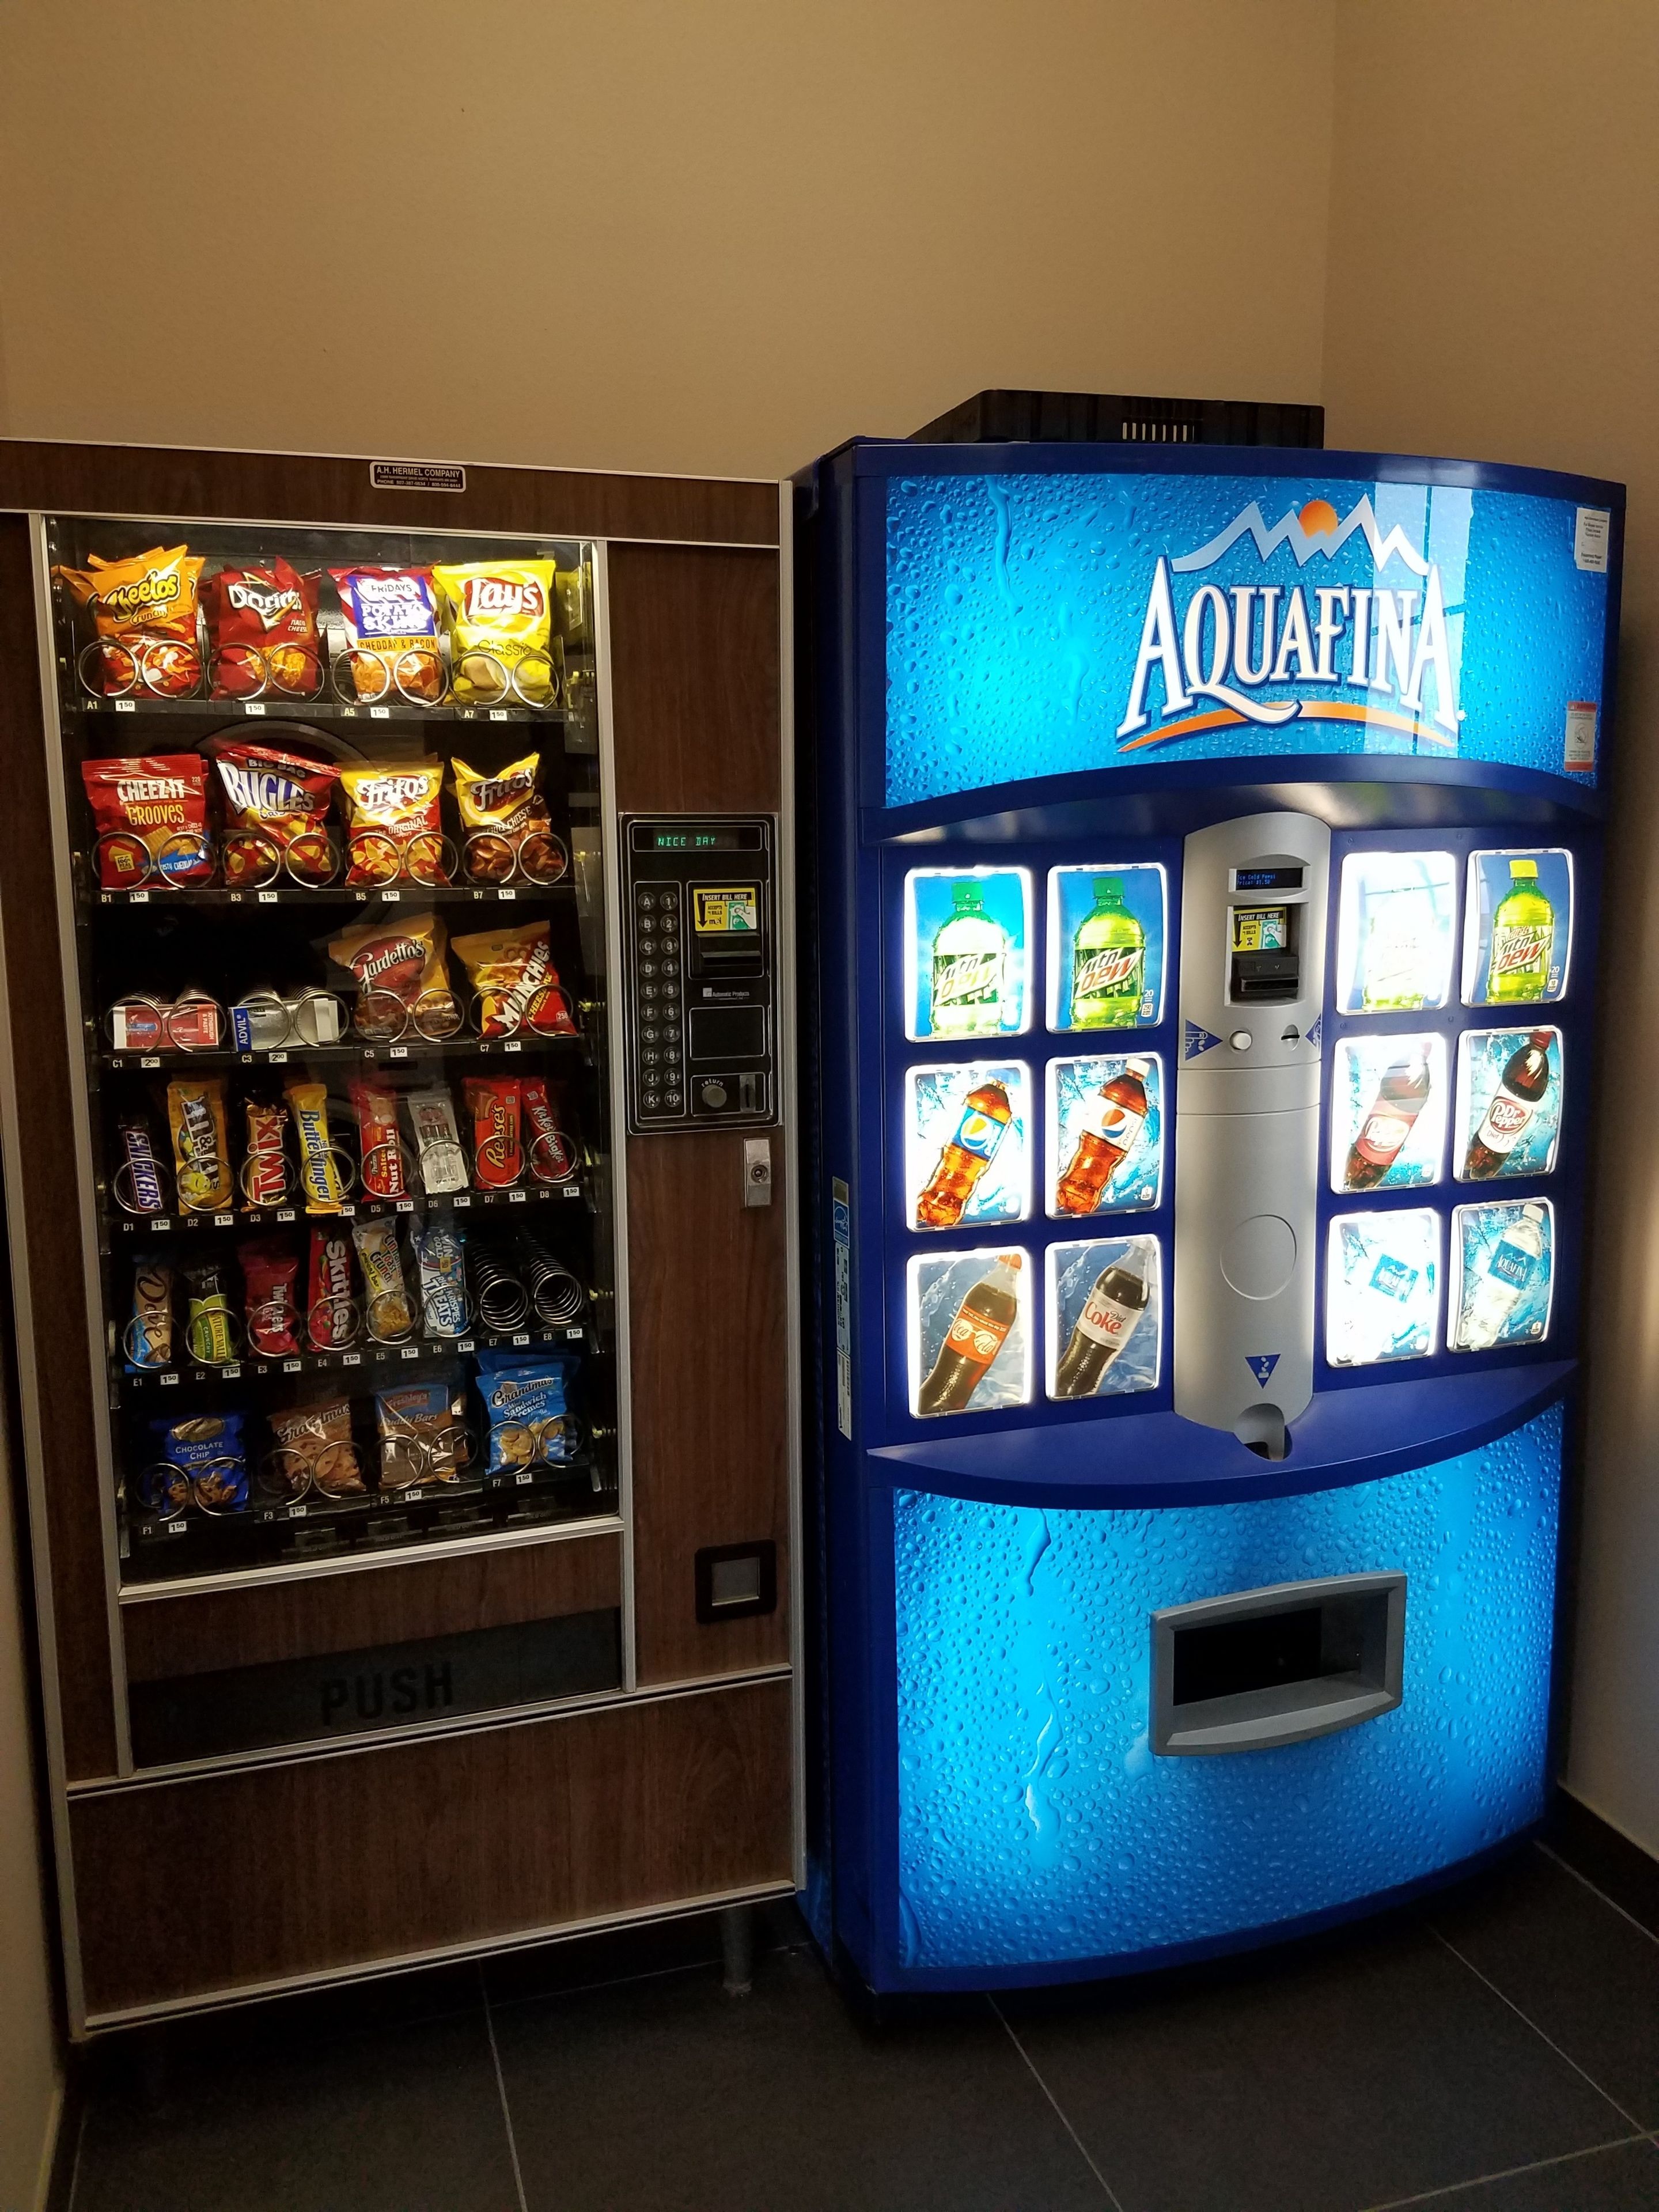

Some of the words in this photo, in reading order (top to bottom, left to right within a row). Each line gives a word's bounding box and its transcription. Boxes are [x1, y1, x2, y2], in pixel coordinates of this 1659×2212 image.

[393, 467, 423, 476] HERMEL
[425, 469, 460, 478] COMPANY
[228, 584, 302, 614] Doritos
[402, 639, 406, 648] &
[478, 640, 531, 657] Classic
[1116, 556, 1459, 738] AQUAFINA
[87, 700, 97, 710] A1
[344, 708, 355, 716] A5
[464, 710, 474, 718] A7
[217, 761, 315, 815] BUGLES
[658, 837, 686, 846] NICE
[695, 836, 716, 846] DAY
[101, 894, 111, 903] B1
[231, 894, 241, 902] B3
[356, 893, 366, 901] B5
[474, 891, 483, 899] B7
[645, 964, 652, 972] D
[667, 964, 673, 972] 4
[241, 1055, 252, 1063] C3
[365, 1050, 374, 1058] C5
[647, 1052, 654, 1060] H
[113, 1059, 123, 1068] C1
[649, 1074, 653, 1082] J
[701, 1078, 724, 1088] return
[299, 1110, 330, 1200] Butterfinger
[126, 1131, 161, 1211] SNICKERS
[123, 1223, 134, 1231] D1
[434, 1237, 444, 1258] GOLD
[370, 1251, 393, 1282] Crunch
[381, 1251, 396, 1273] Toast
[326, 1240, 351, 1340] Skittles
[422, 1278, 453, 1326] TREATS
[446, 1288, 461, 1323] KRISPIES
[1085, 1301, 1122, 1335] Coke
[1109, 1310, 1126, 1324] Diet
[196, 1372, 205, 1380] E2
[503, 1392, 546, 1418] Sandwich
[190, 1451, 210, 1460] CHIP
[320, 1662, 454, 1728] PUSH
